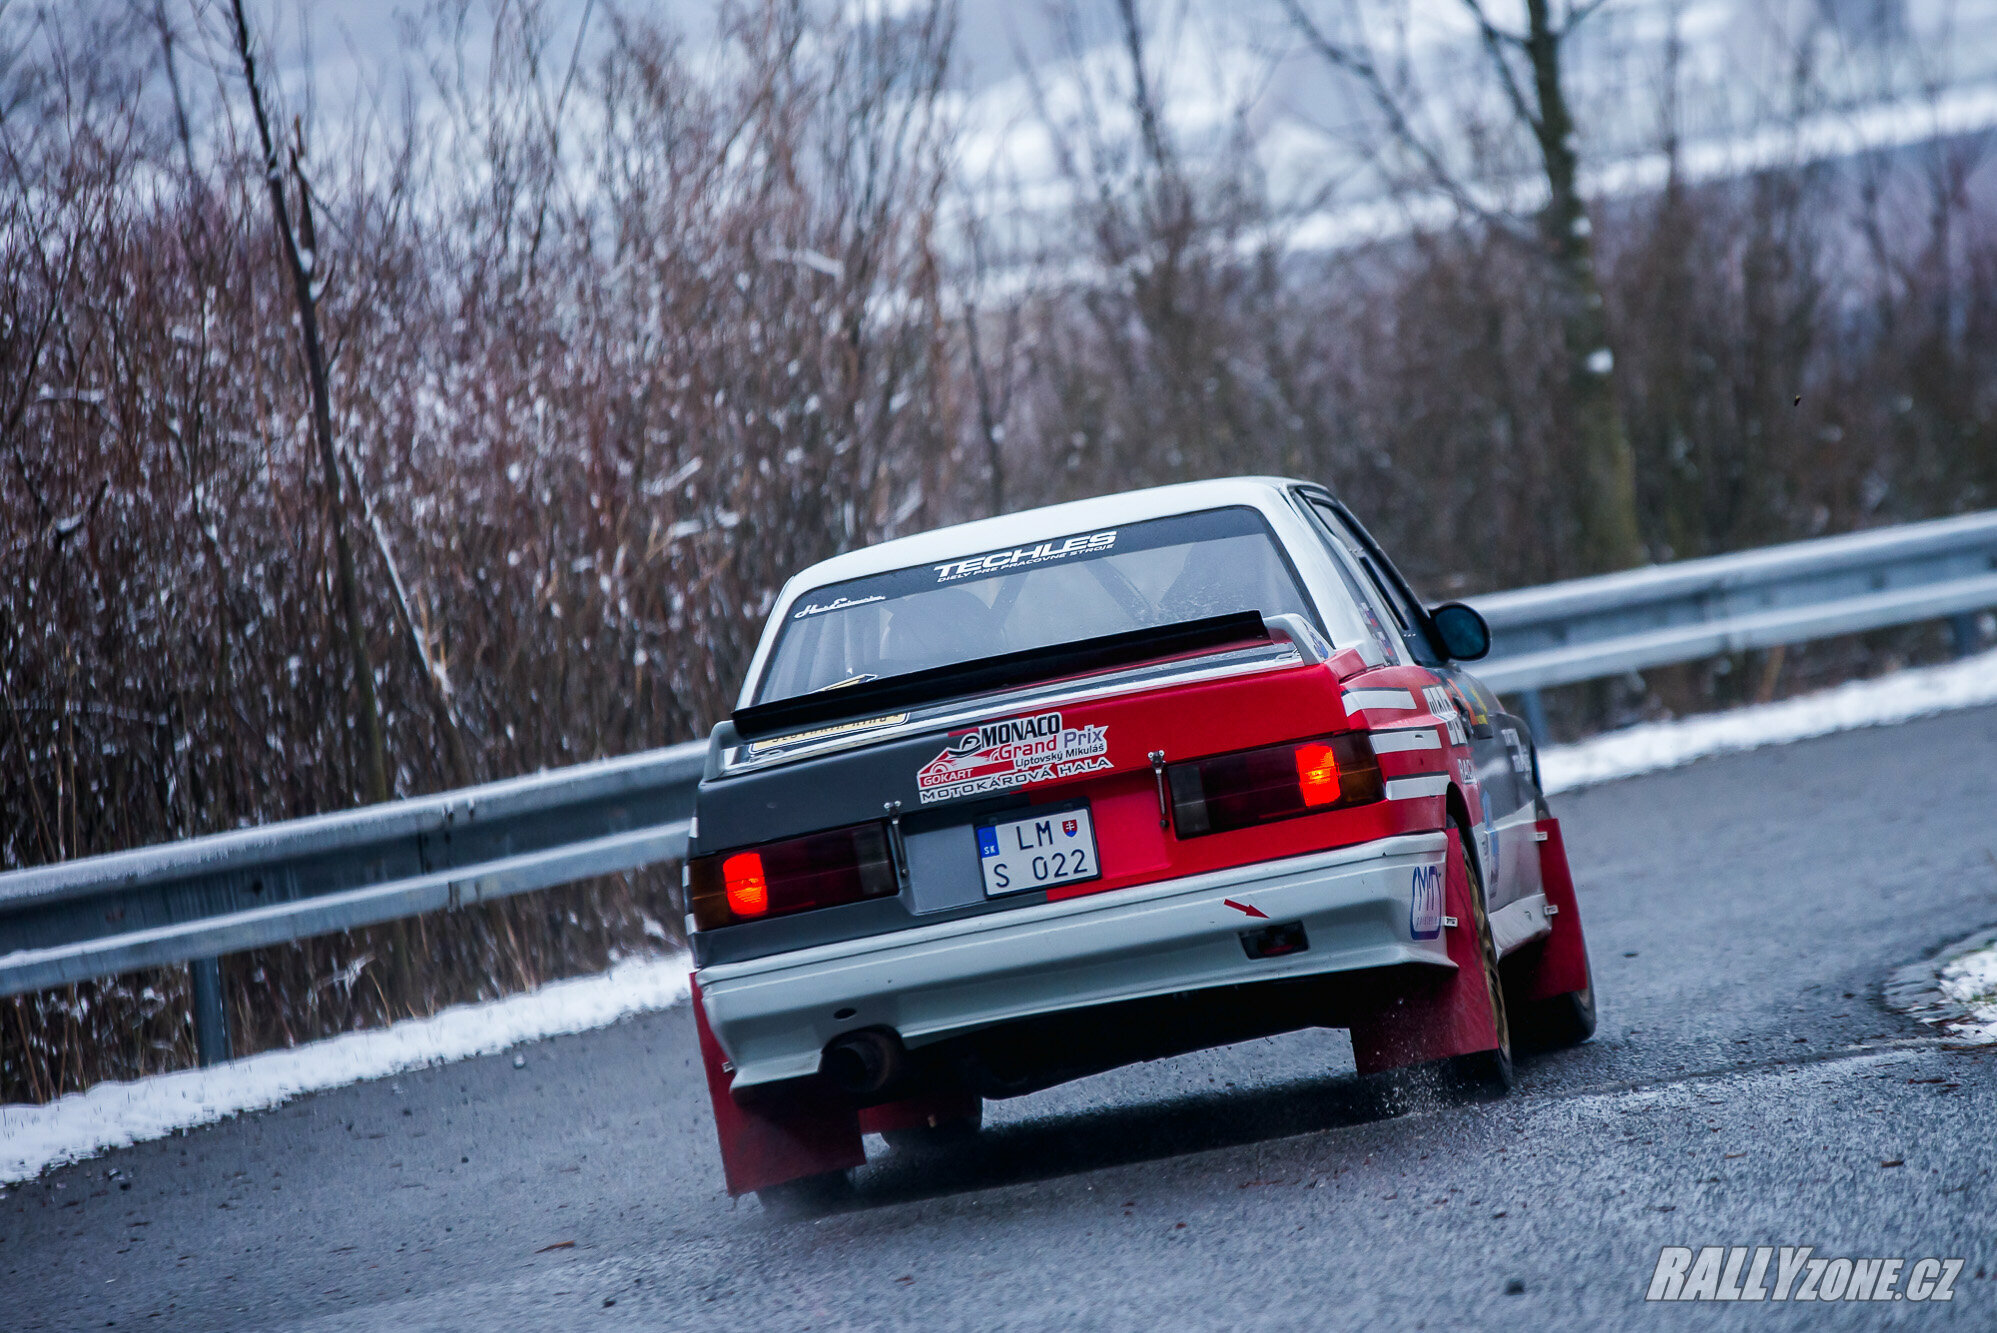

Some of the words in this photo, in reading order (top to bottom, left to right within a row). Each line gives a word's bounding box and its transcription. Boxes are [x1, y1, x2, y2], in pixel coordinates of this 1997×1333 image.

[934, 531, 1117, 577] TECHLES
[937, 571, 971, 583] DIELY
[973, 566, 999, 576] PRE
[1069, 543, 1114, 557] STROJE
[981, 714, 1061, 748] MONACO
[1000, 734, 1057, 759] Grand
[1064, 728, 1104, 748] Prix
[1015, 749, 1063, 768] Liptovský
[1065, 742, 1104, 758] Mikuláš
[922, 765, 1052, 801] MOTOKÁROVÁ
[1060, 759, 1109, 775] HALA
[923, 768, 973, 786] GOKART
[984, 845, 996, 855] SK
[1016, 820, 1053, 851] LM
[993, 863, 1010, 888] S
[1032, 849, 1088, 881] 022
